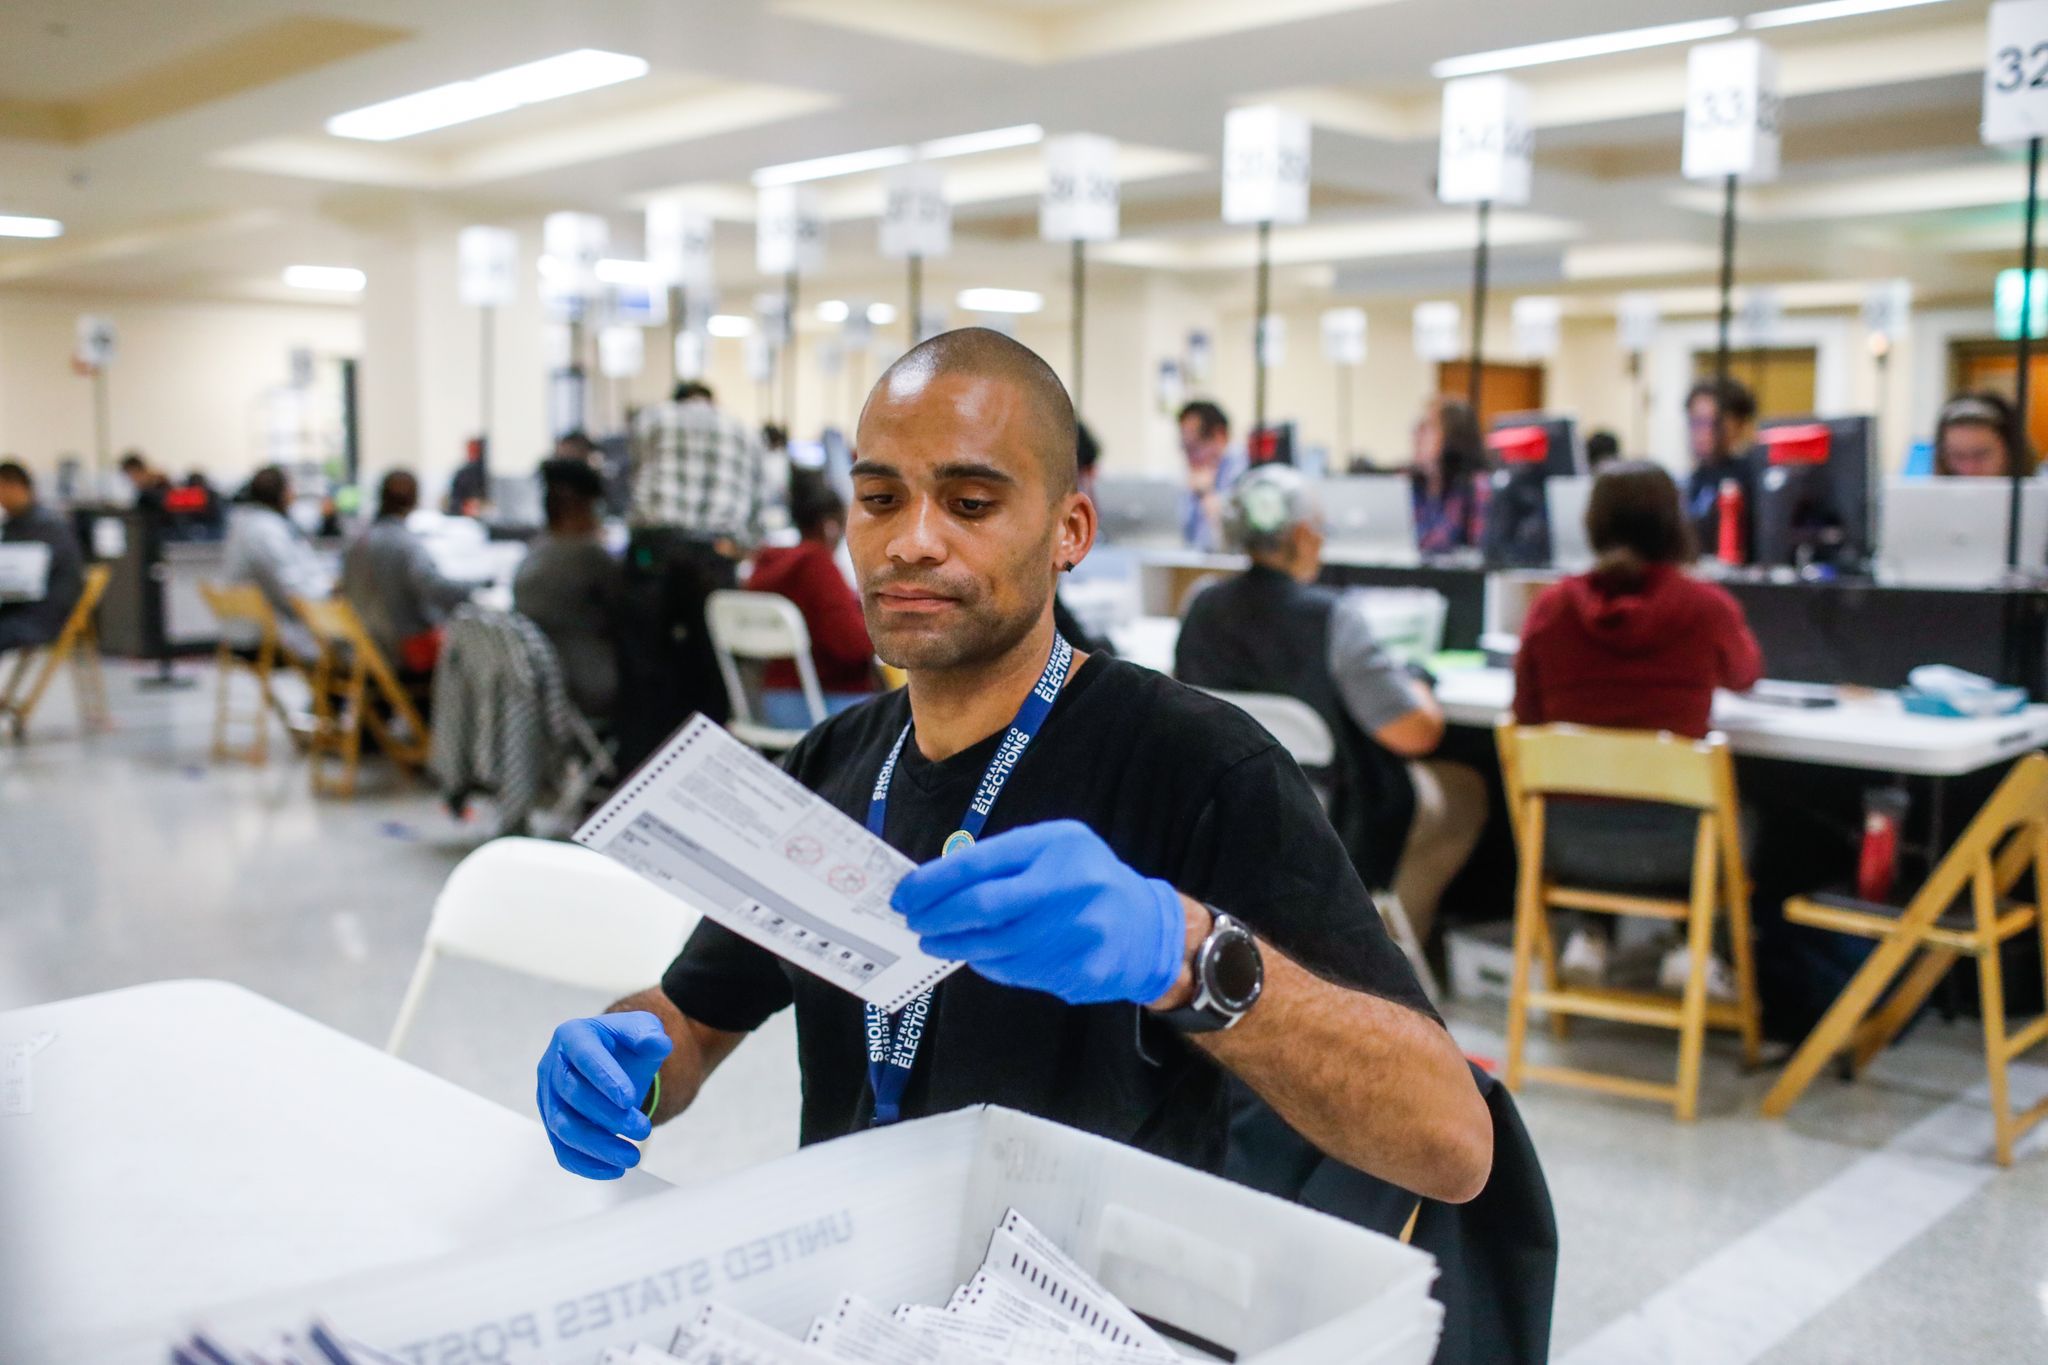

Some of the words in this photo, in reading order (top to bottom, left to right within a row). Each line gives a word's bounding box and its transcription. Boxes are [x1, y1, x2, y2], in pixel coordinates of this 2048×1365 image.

[1995, 42, 2048, 93] 32
[1034, 676, 1049, 696] SAN
[971, 788, 986, 811] SAN
[982, 727, 1019, 787] FRANCISCO
[976, 732, 1030, 816] ELECTIONS
[866, 1001, 884, 1062] CTIONS
[880, 1010, 892, 1061] ANCISC
[890, 1043, 904, 1066] SAN
[897, 1000, 916, 1042] FRANCI
